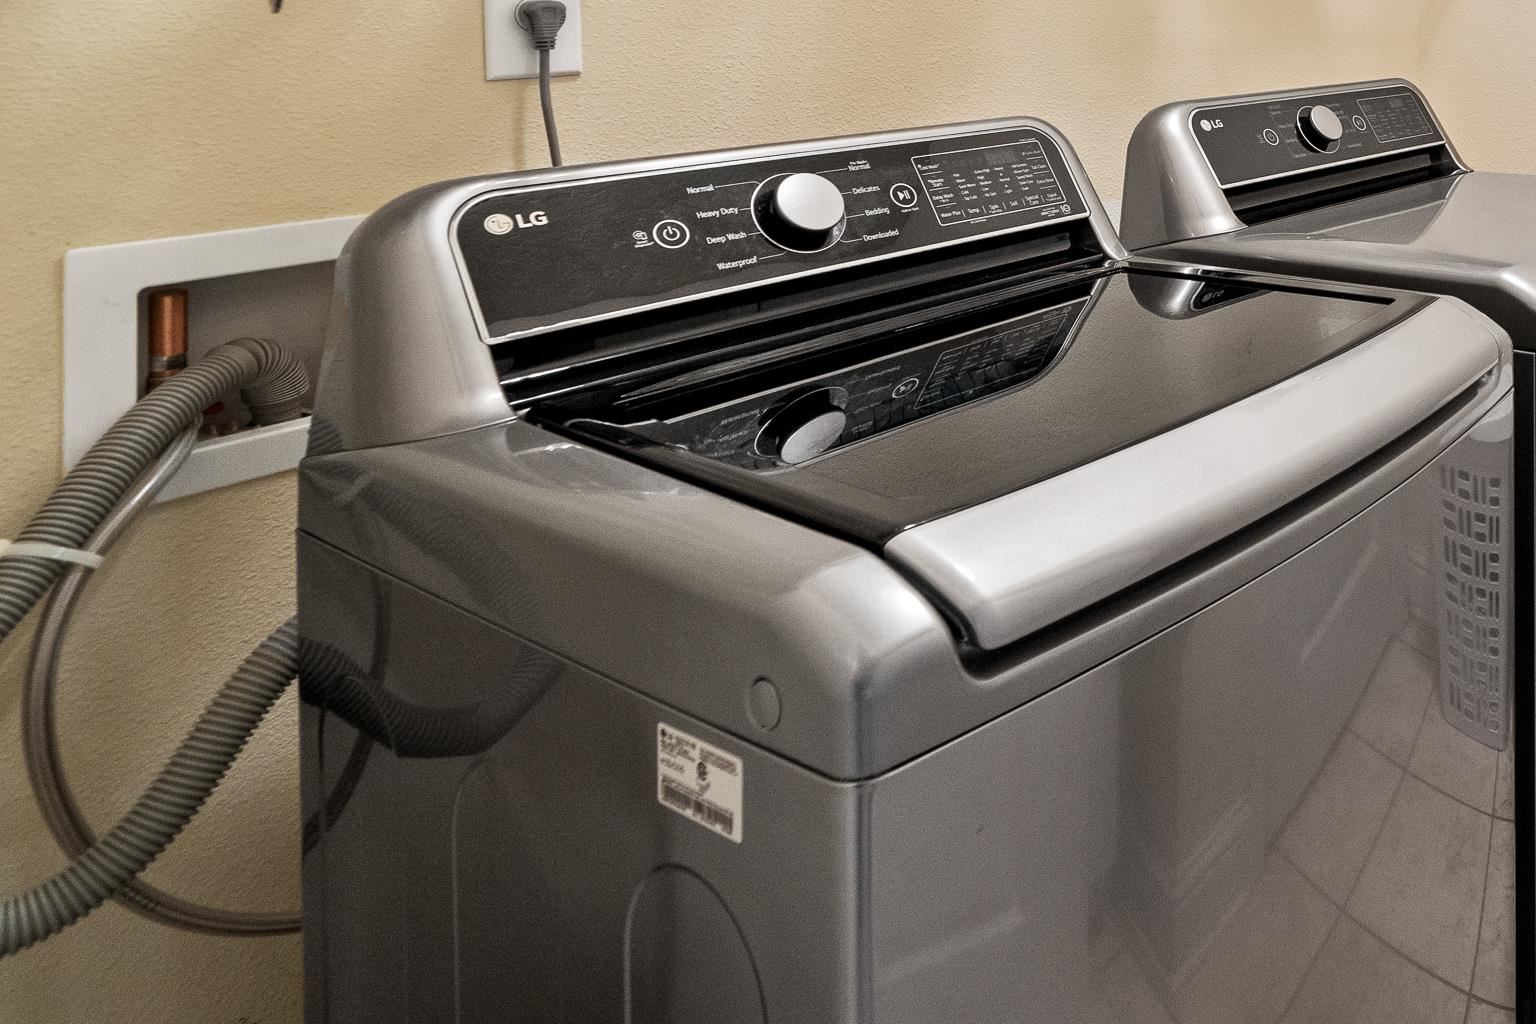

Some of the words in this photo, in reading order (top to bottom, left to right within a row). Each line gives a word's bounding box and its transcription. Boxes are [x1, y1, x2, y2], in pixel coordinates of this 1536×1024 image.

[1210, 119, 1224, 129] LG
[848, 162, 871, 172] Normal
[686, 184, 715, 194] Normal
[852, 186, 880, 195] Delicates
[696, 210, 720, 219] Heavy
[720, 207, 739, 216] Duty
[865, 207, 890, 217] Bedding
[515, 210, 549, 228] LG
[706, 235, 727, 245] Deep
[726, 231, 747, 240] Wash
[863, 228, 900, 242] Downloaded
[716, 256, 758, 270] Waterproof
